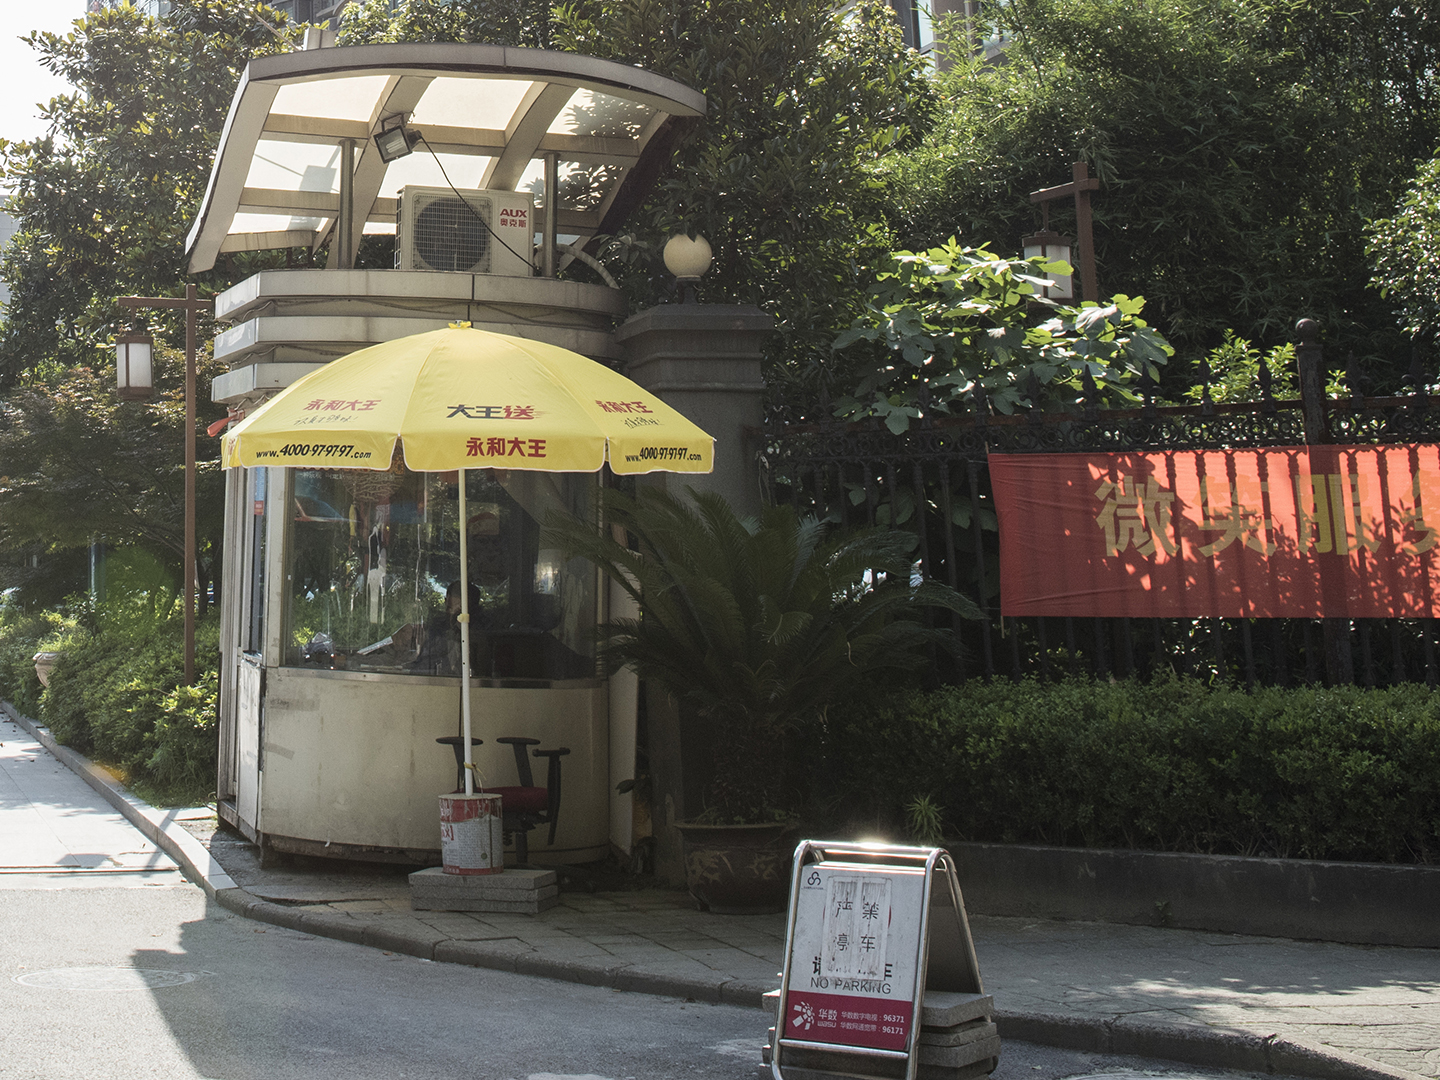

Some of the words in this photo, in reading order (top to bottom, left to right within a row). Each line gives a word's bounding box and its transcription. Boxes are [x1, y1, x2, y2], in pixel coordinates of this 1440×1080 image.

[500, 209, 527, 218] AUX
[500, 218, 527, 228] 奥克斯
[303, 399, 381, 411] 永和大王
[595, 400, 653, 413] 永和大王
[446, 404, 535, 420] 大王送
[466, 437, 547, 458] 永和大王
[810, 977, 829, 989] NO
[834, 979, 891, 994] PARKING
[818, 1008, 838, 1021] 华数
[883, 1014, 905, 1023] 96371
[882, 1026, 904, 1035] 96171
